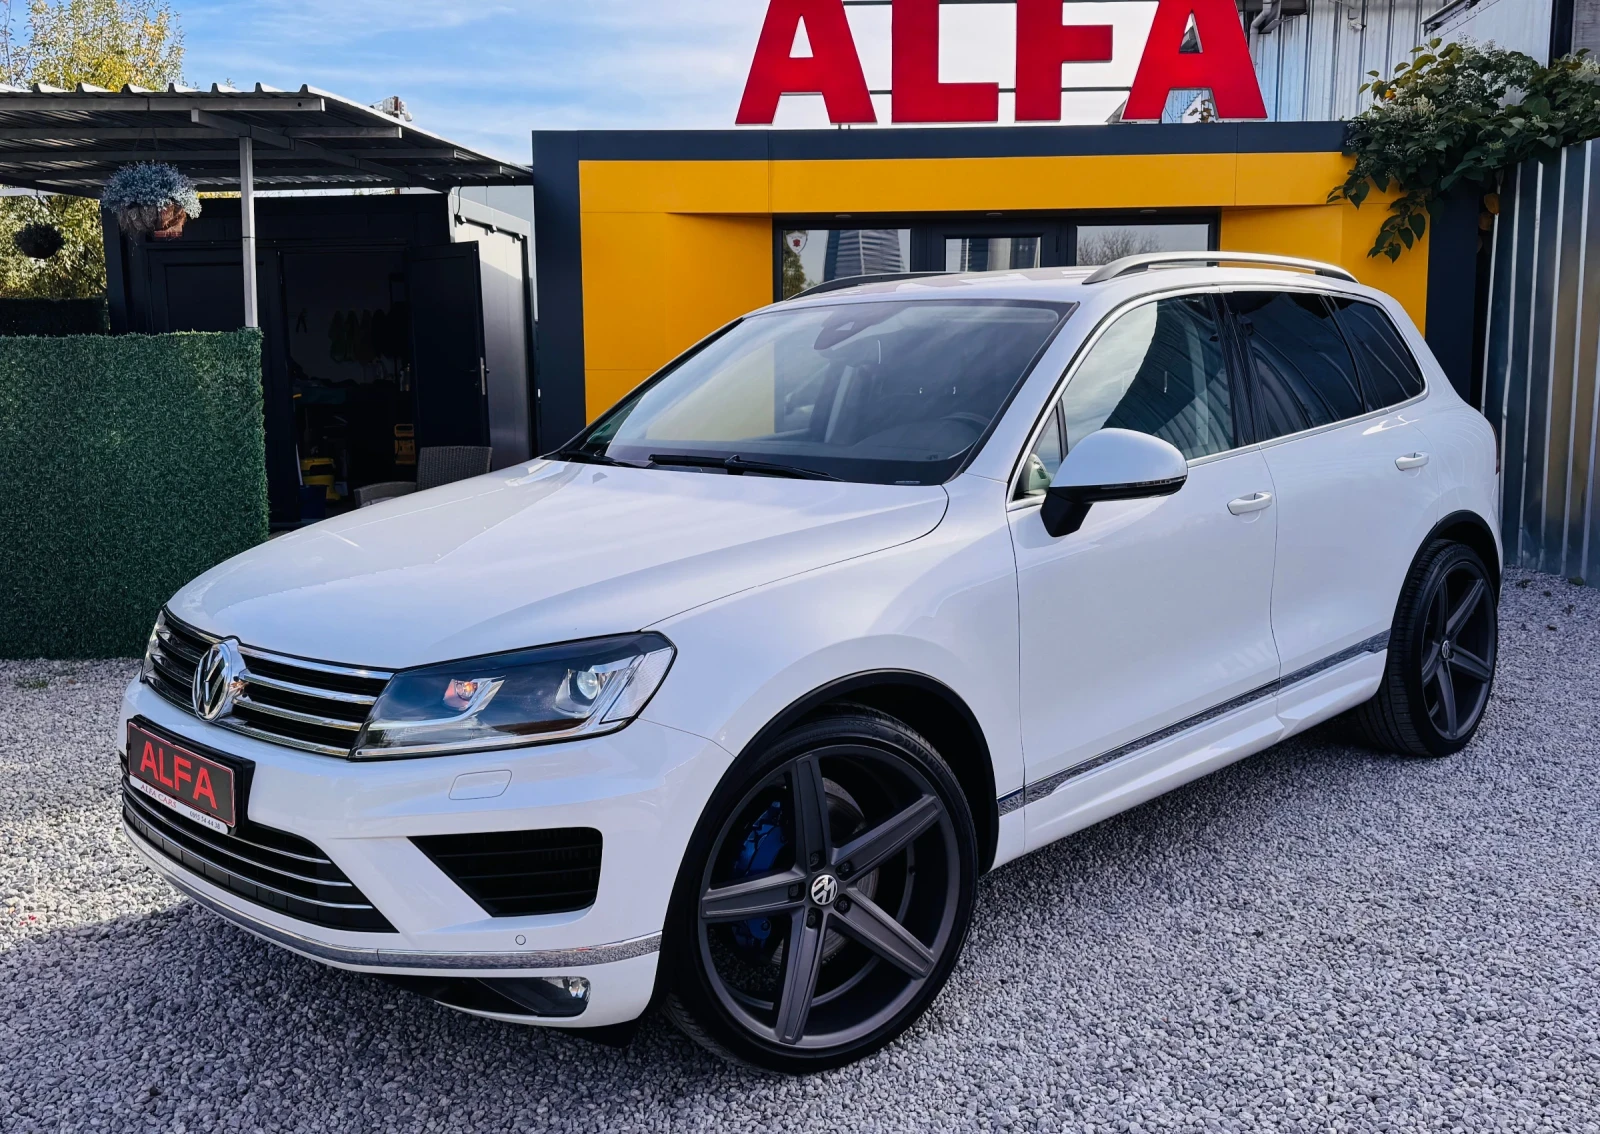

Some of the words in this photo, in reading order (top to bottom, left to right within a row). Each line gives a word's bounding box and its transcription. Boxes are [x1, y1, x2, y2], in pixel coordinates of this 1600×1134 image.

[735, 0, 1268, 125] ALFA
[140, 741, 217, 810] ALFA
[140, 783, 157, 798] ALFA
[158, 793, 177, 809] CARS
